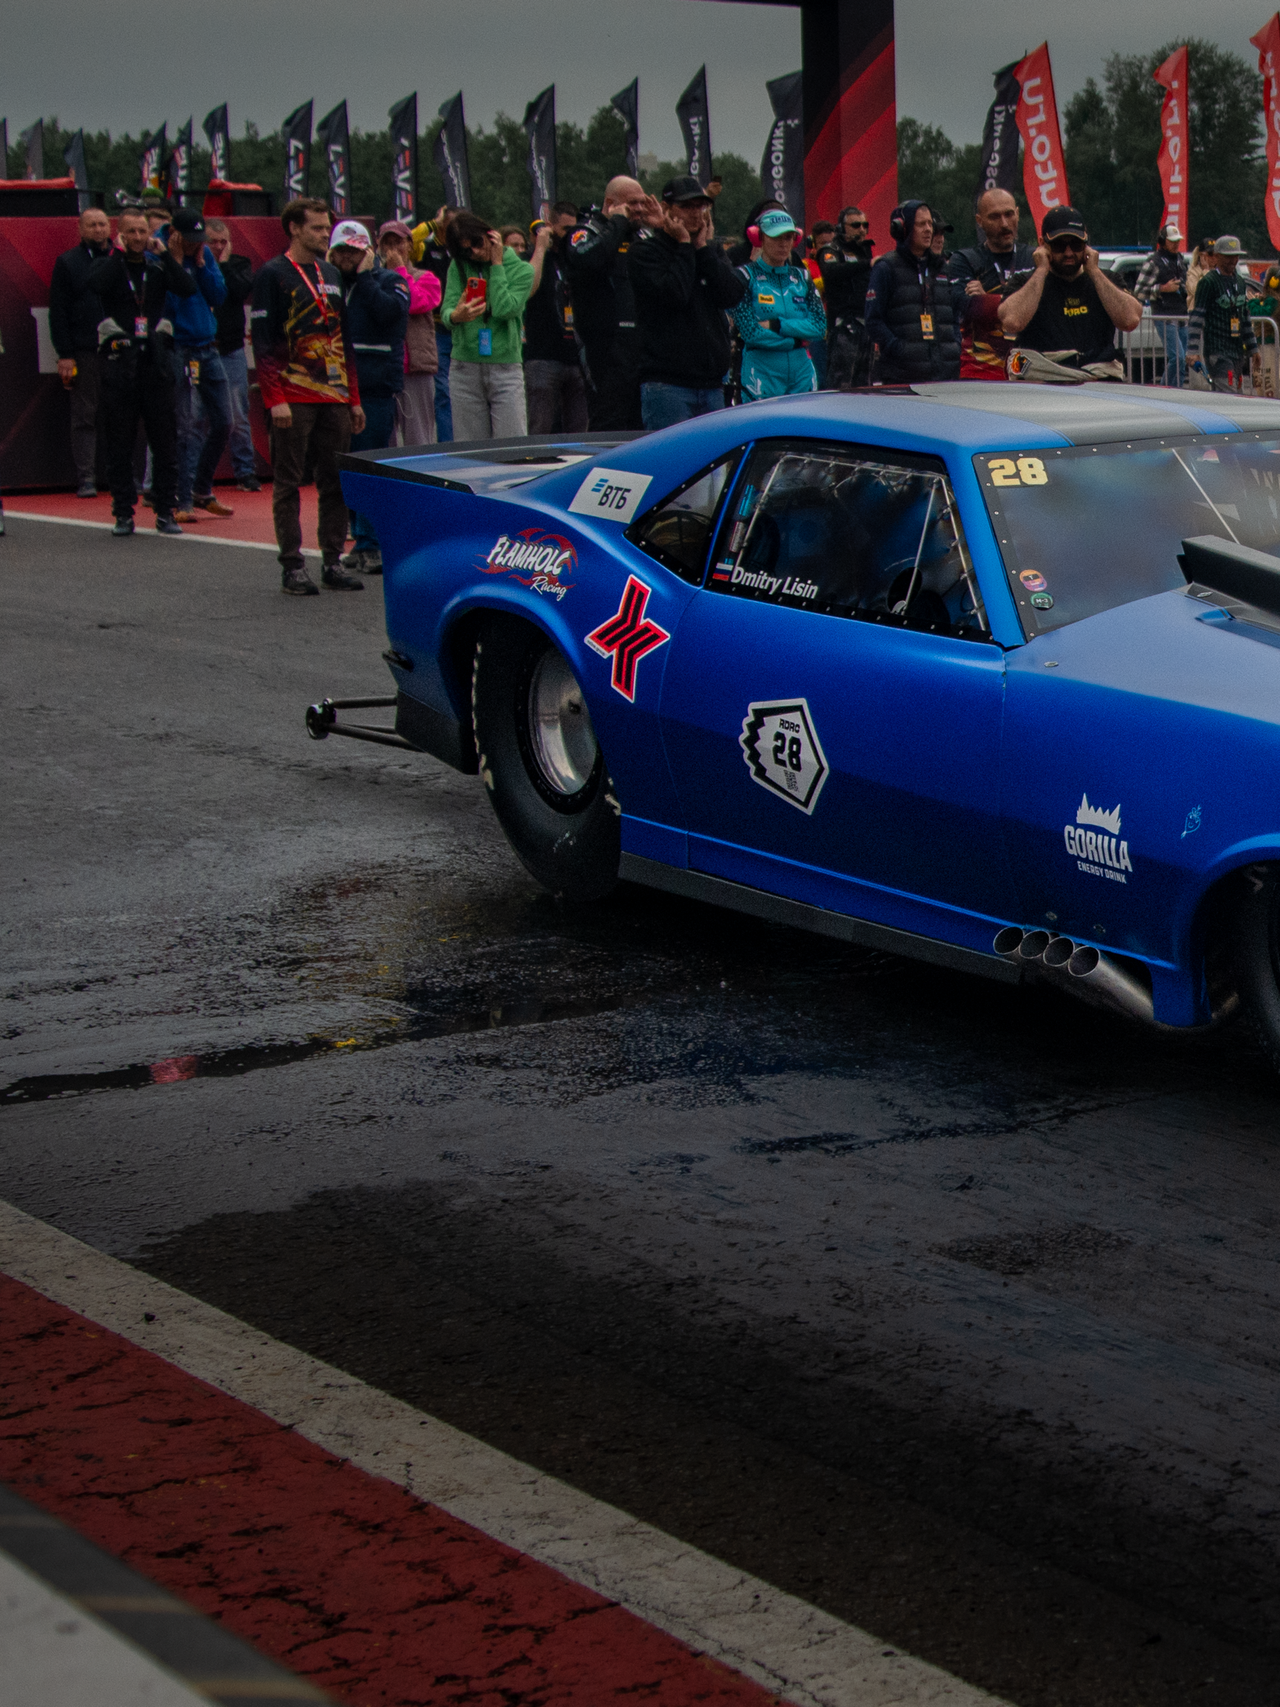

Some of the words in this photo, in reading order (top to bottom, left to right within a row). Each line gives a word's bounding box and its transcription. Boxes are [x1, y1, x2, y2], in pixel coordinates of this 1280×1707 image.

[987, 457, 1049, 486] 28
[598, 485, 632, 510] ВТБ
[530, 575, 567, 602] Racing
[730, 566, 782, 595] Dmitry
[781, 576, 819, 599] Lisin
[779, 719, 800, 733] RDRC
[772, 731, 802, 772] 28
[1064, 824, 1133, 872] GORILLA
[1077, 860, 1104, 878] ENERGY
[1104, 868, 1127, 884] DRINK
